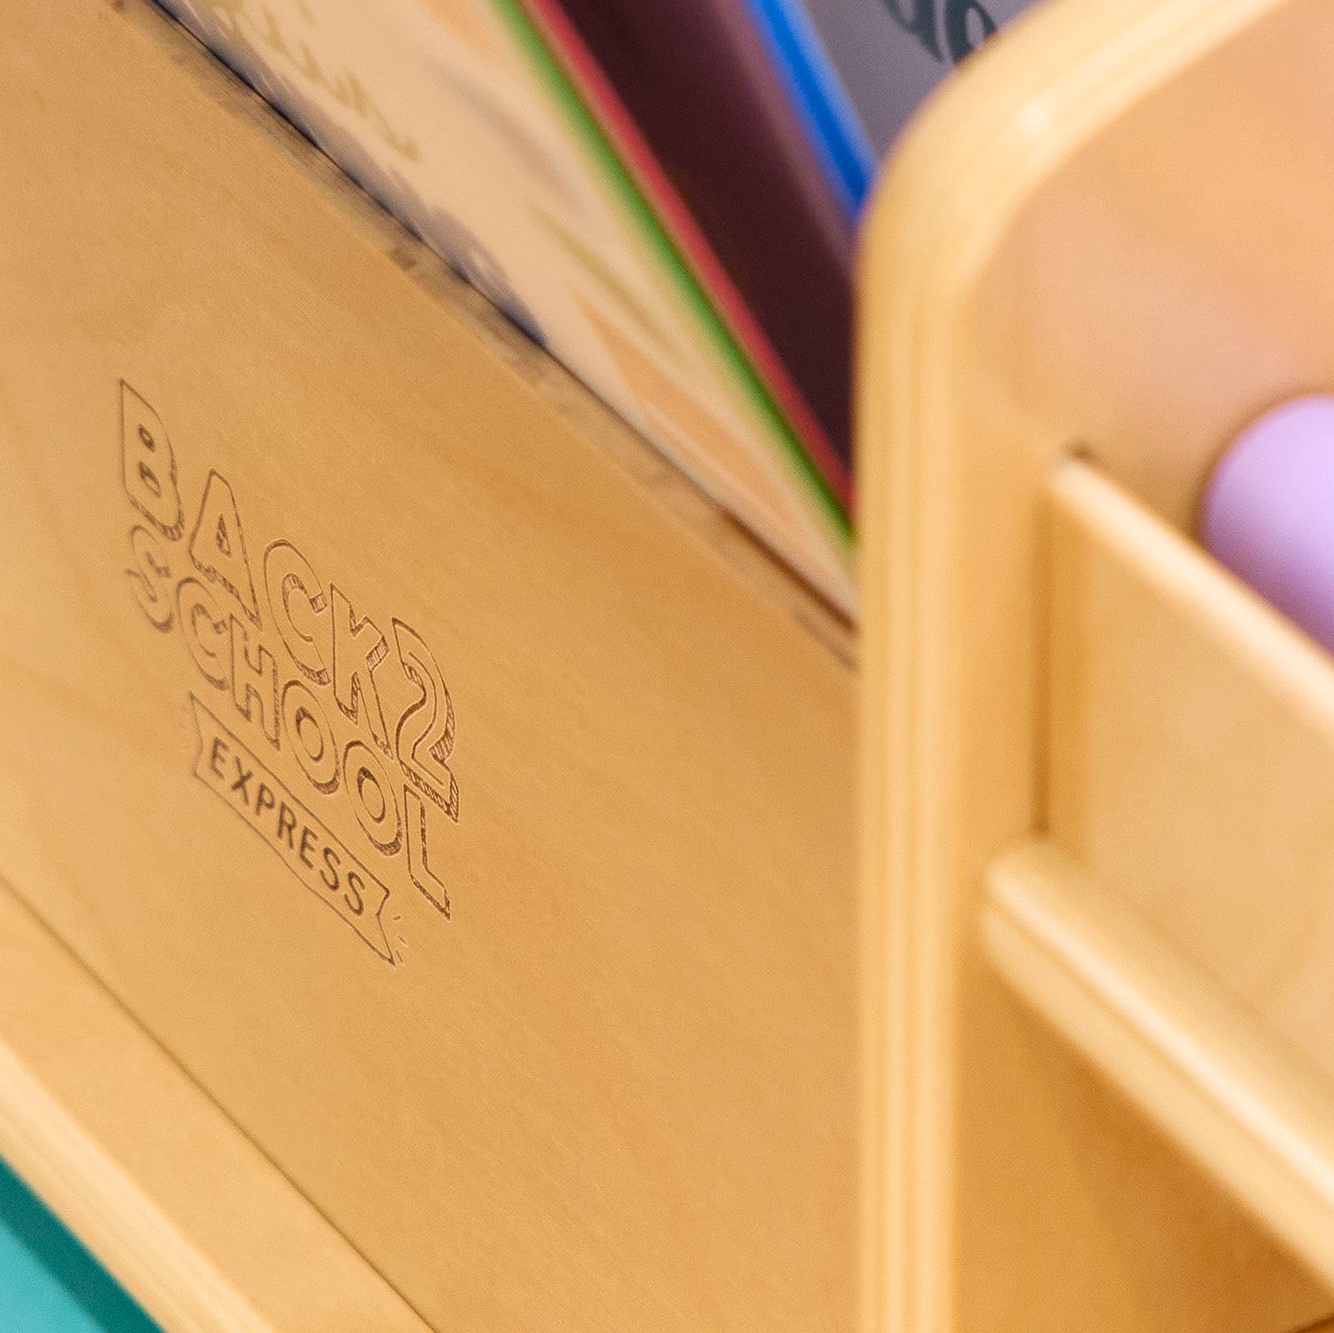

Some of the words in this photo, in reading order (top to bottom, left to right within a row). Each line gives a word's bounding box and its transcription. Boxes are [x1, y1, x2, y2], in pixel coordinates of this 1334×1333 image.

[119, 378, 459, 823] BACK2
[127, 523, 452, 920] SCHOOL
[209, 736, 367, 918] EXPRESS
